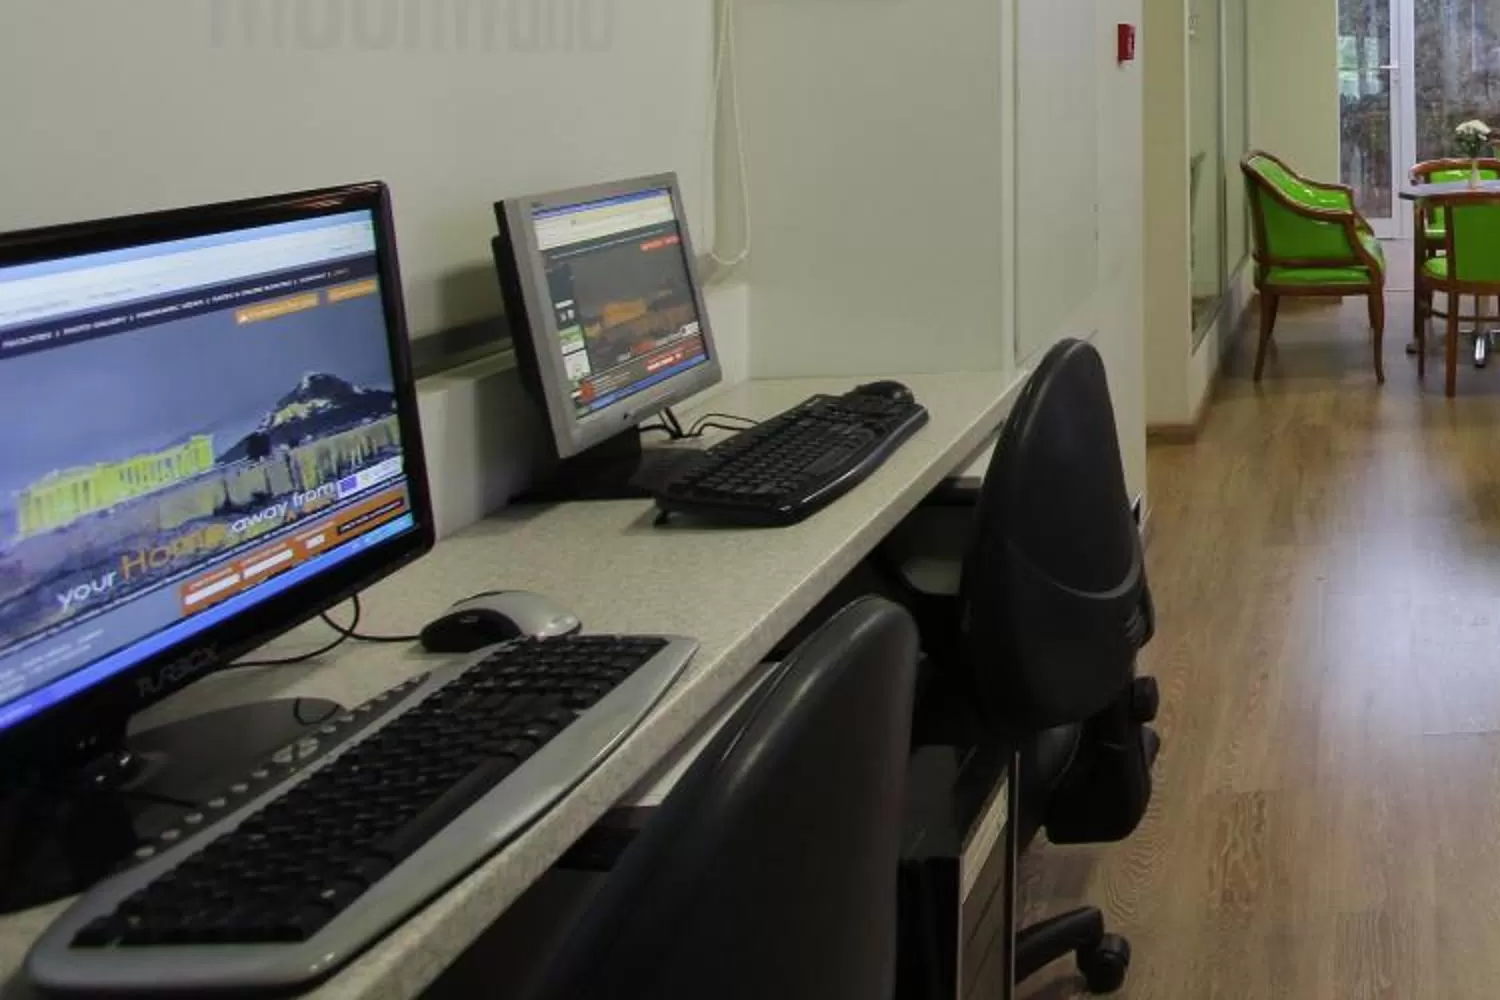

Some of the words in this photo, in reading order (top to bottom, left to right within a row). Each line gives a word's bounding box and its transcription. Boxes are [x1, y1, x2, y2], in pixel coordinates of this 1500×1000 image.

[56, 571, 117, 614] your
[231, 500, 288, 534] away
[292, 481, 335, 508] from
